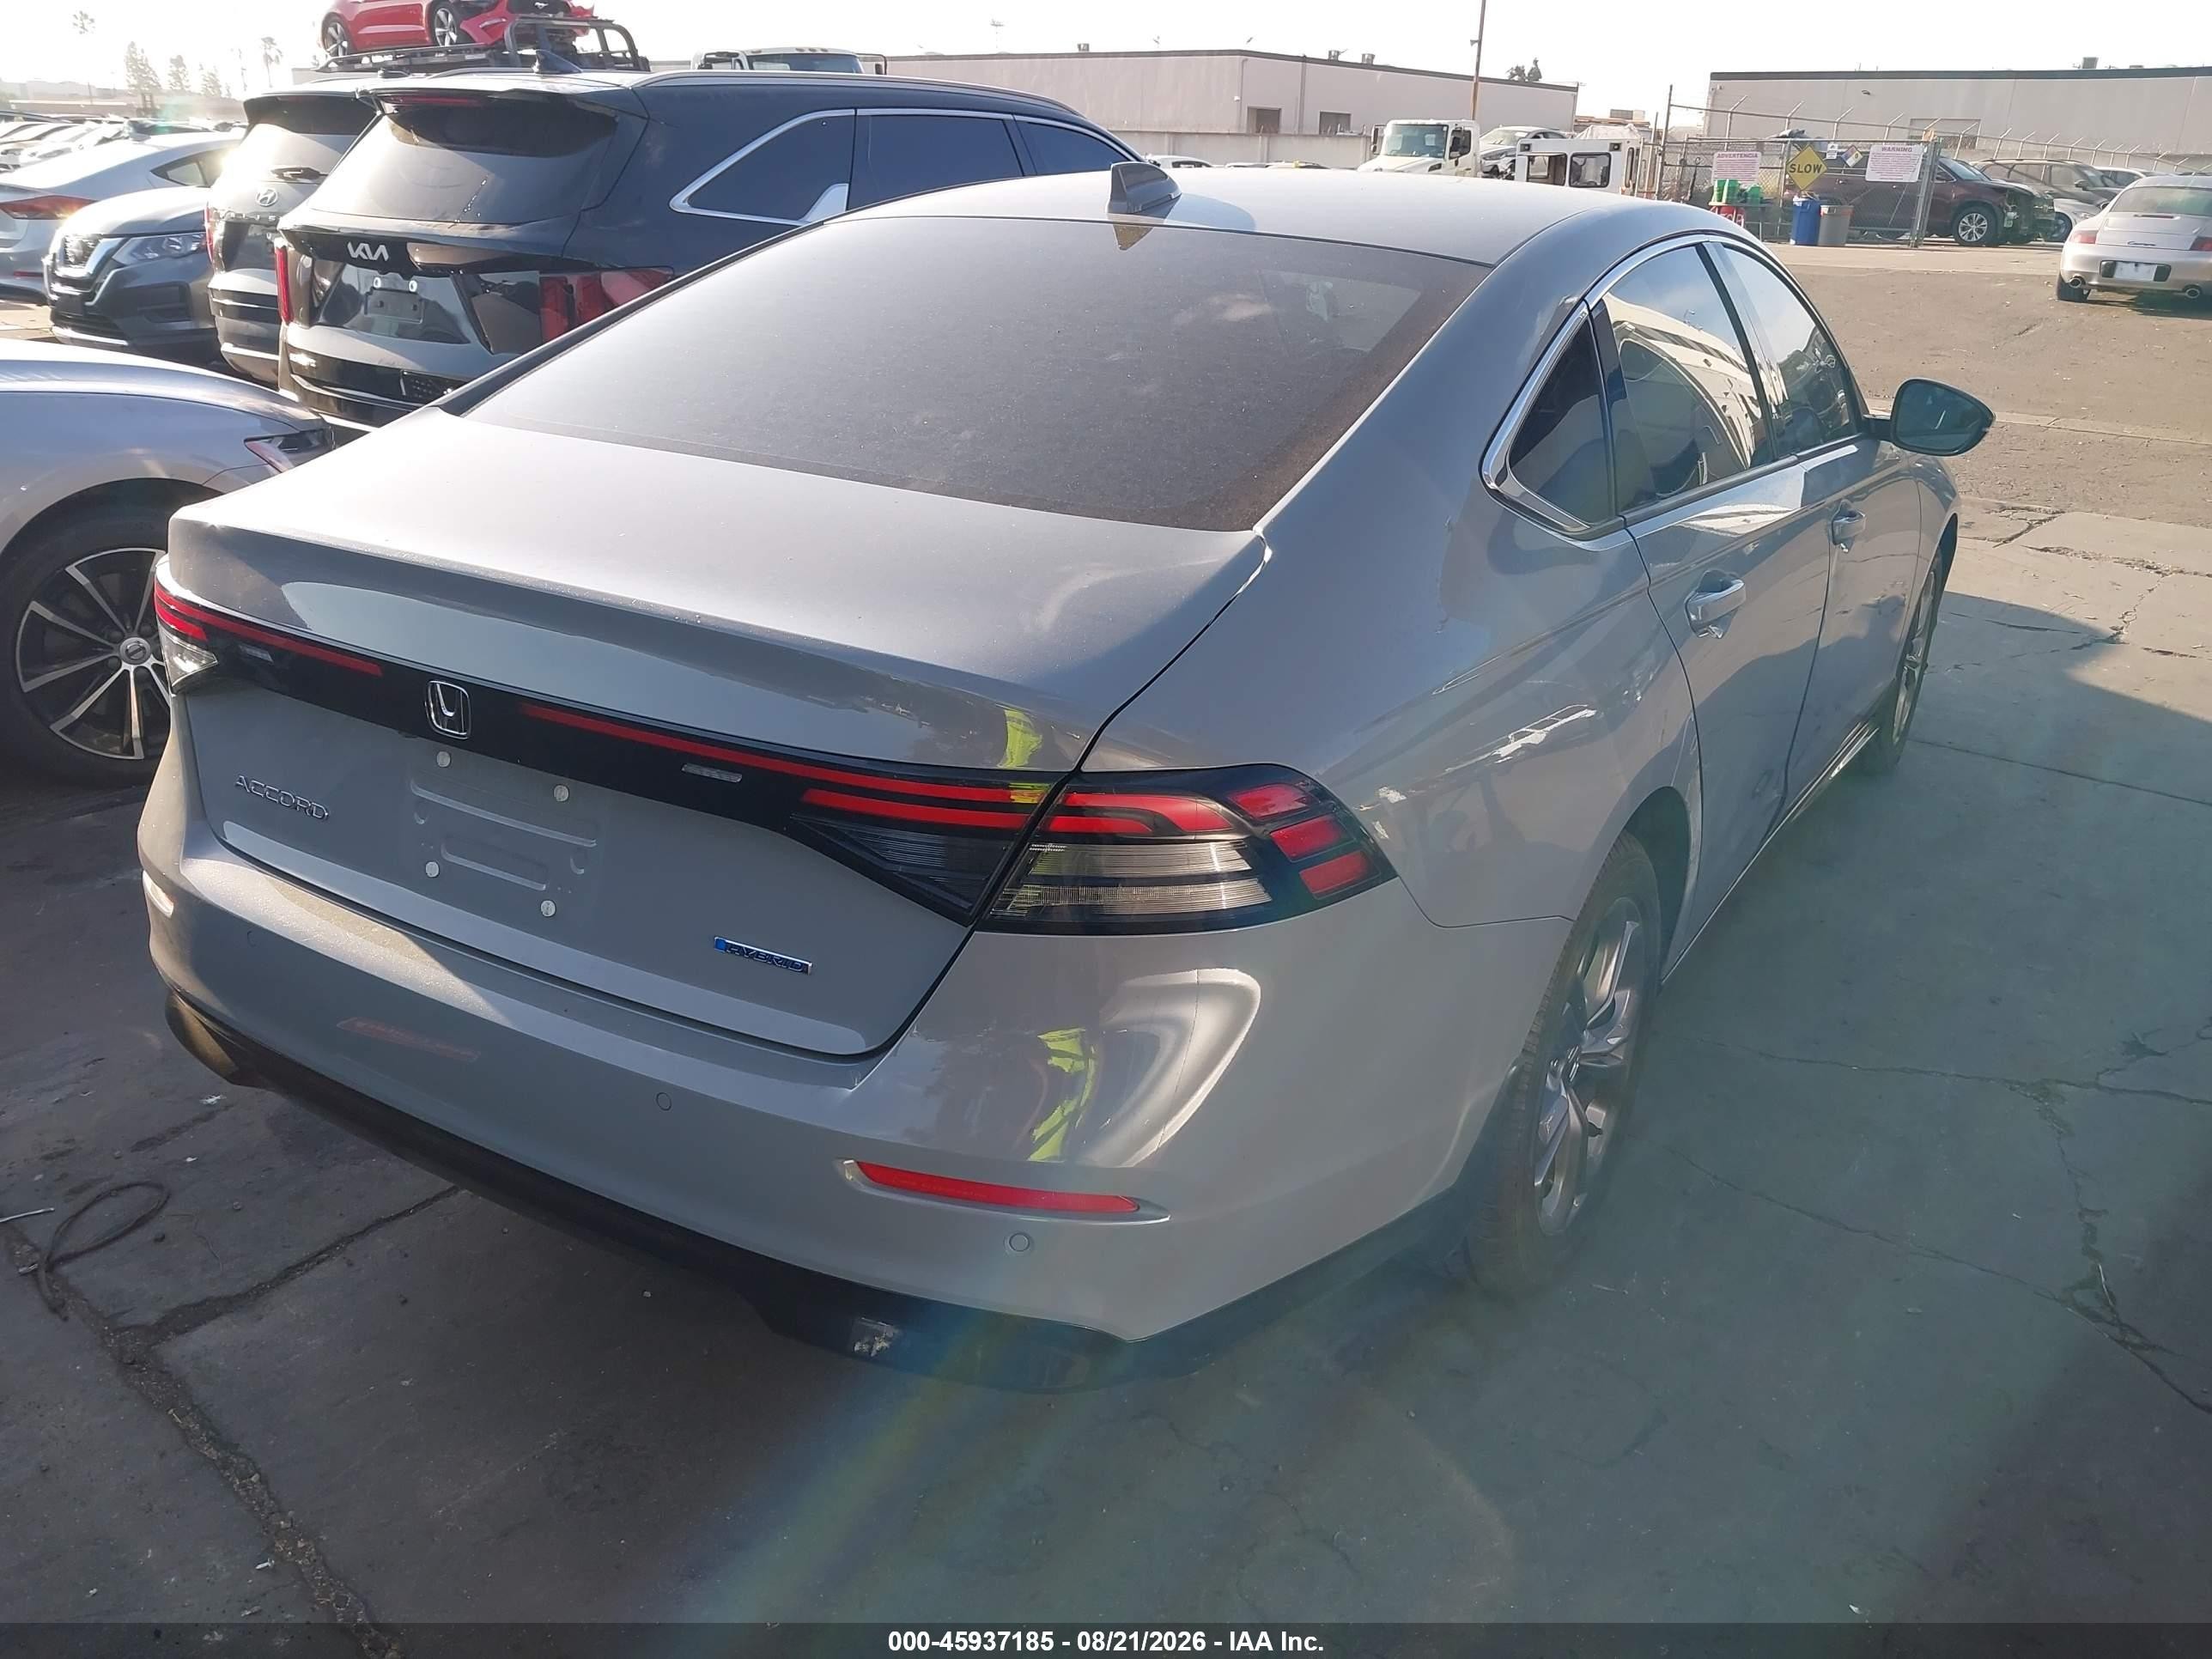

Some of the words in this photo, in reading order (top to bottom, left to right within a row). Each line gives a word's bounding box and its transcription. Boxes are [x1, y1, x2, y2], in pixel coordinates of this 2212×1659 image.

[1789, 163, 1823, 173] SLOW
[347, 240, 389, 261] KIA
[234, 775, 329, 819] ACCORD
[726, 943, 805, 973] HYBRID
